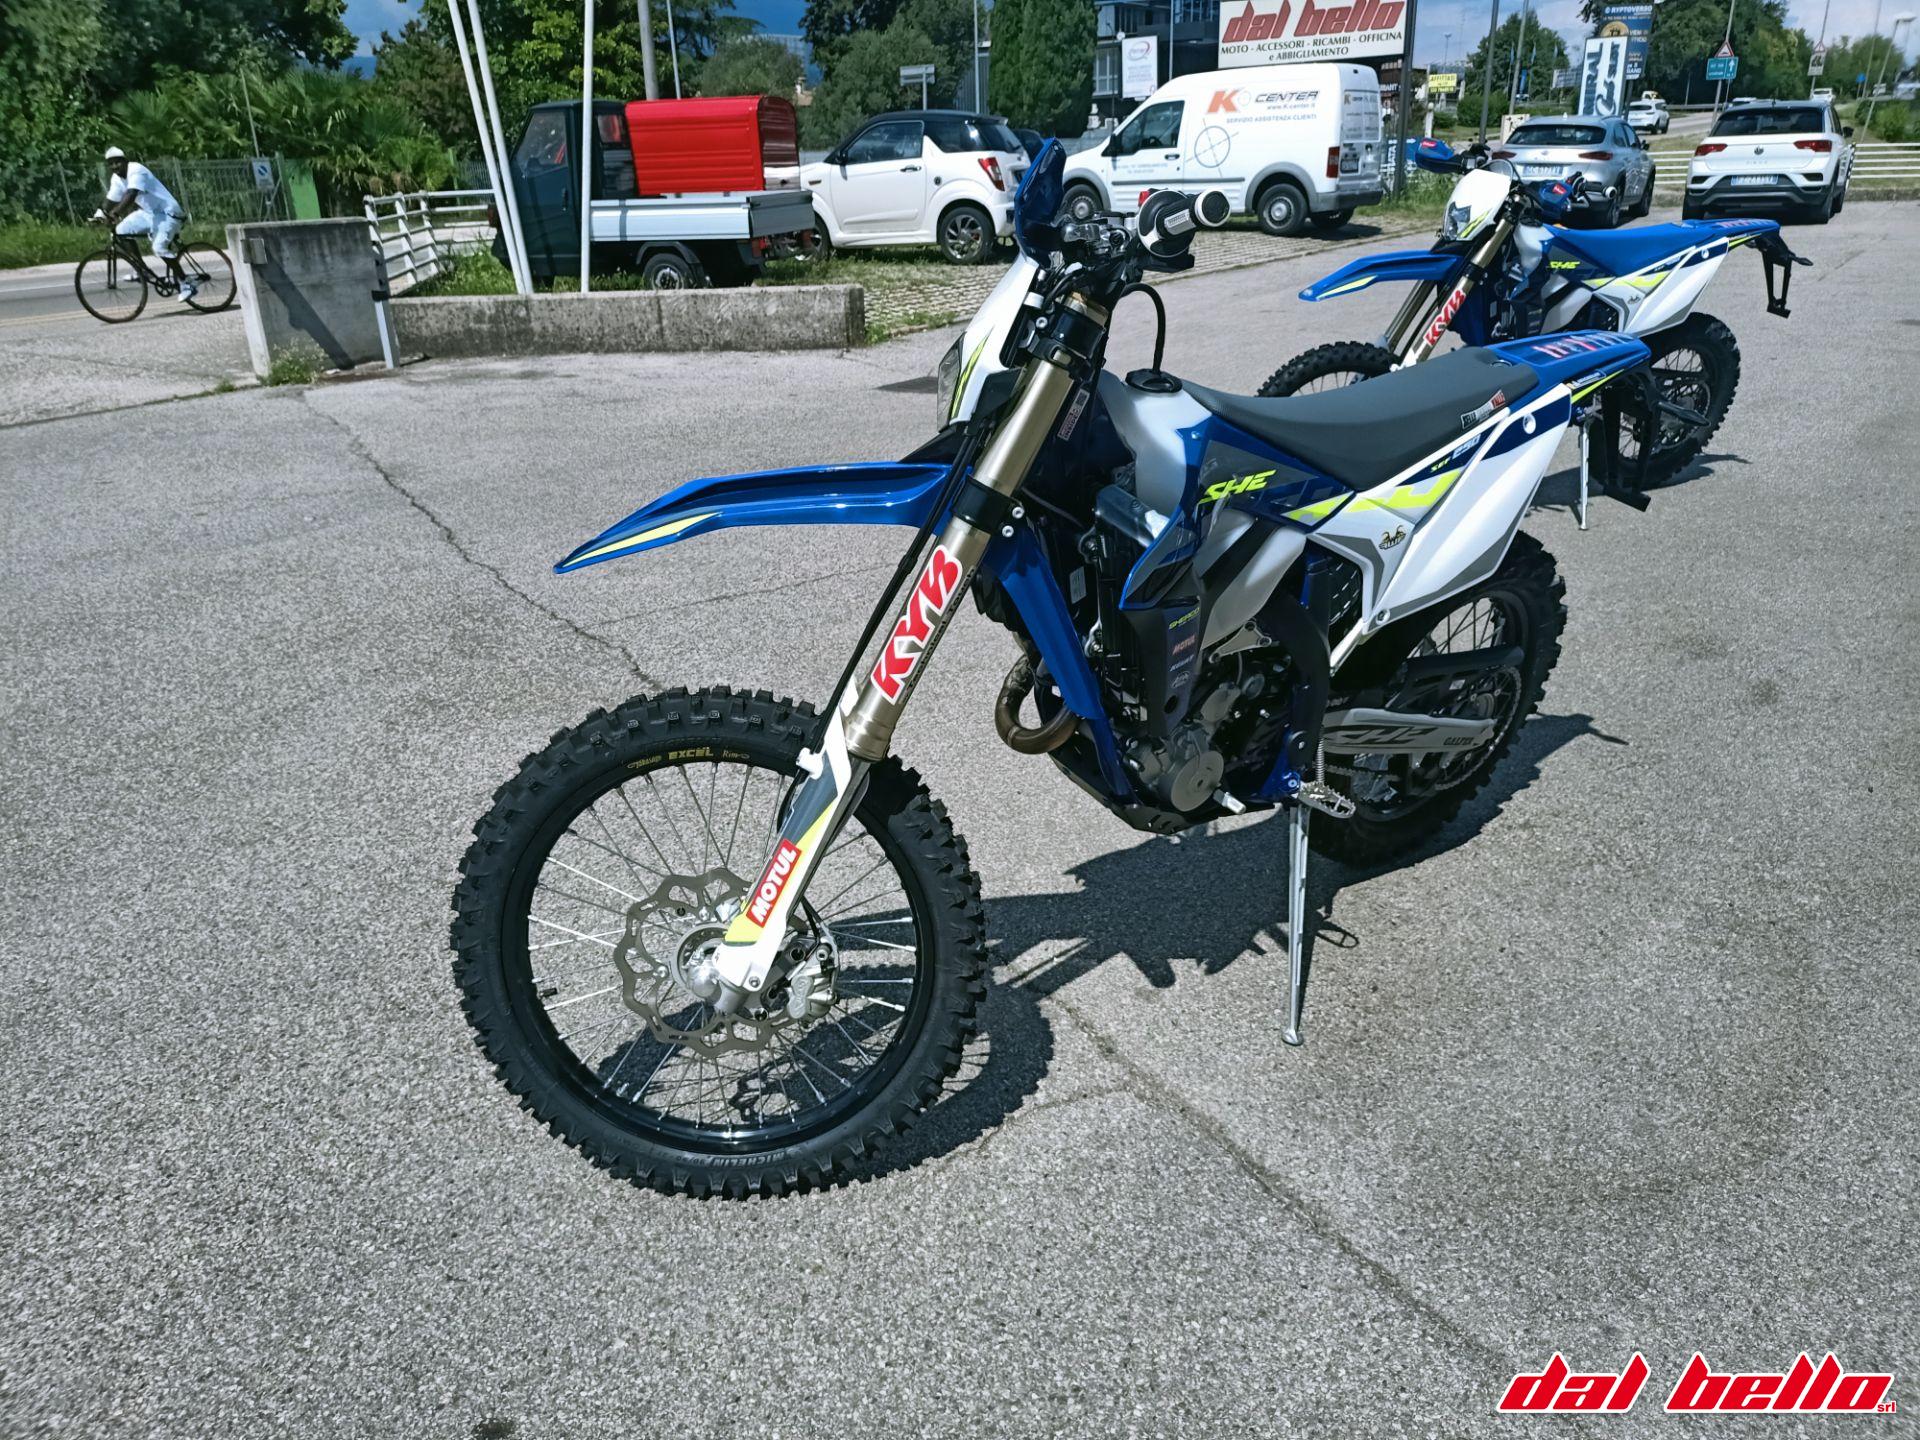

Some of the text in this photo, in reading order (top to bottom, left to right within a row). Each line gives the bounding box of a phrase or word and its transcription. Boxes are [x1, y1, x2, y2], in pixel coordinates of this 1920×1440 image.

[1222, 0, 1404, 43] dal bello
[1221, 45, 1249, 55] MOTO
[1256, 42, 1305, 51] ACCESSORI
[1312, 37, 1351, 47] RICAMBI
[1359, 31, 1402, 43] OFFICINA
[1275, 47, 1349, 61] ABBIGLIAMENTO
[1255, 90, 1319, 103] CENTER
[1423, 288, 1466, 347] KYB
[871, 545, 962, 705] KYB
[668, 748, 714, 760] EXCEL
[751, 846, 798, 925] MOTUL
[712, 1152, 786, 1167] MICHELIN
